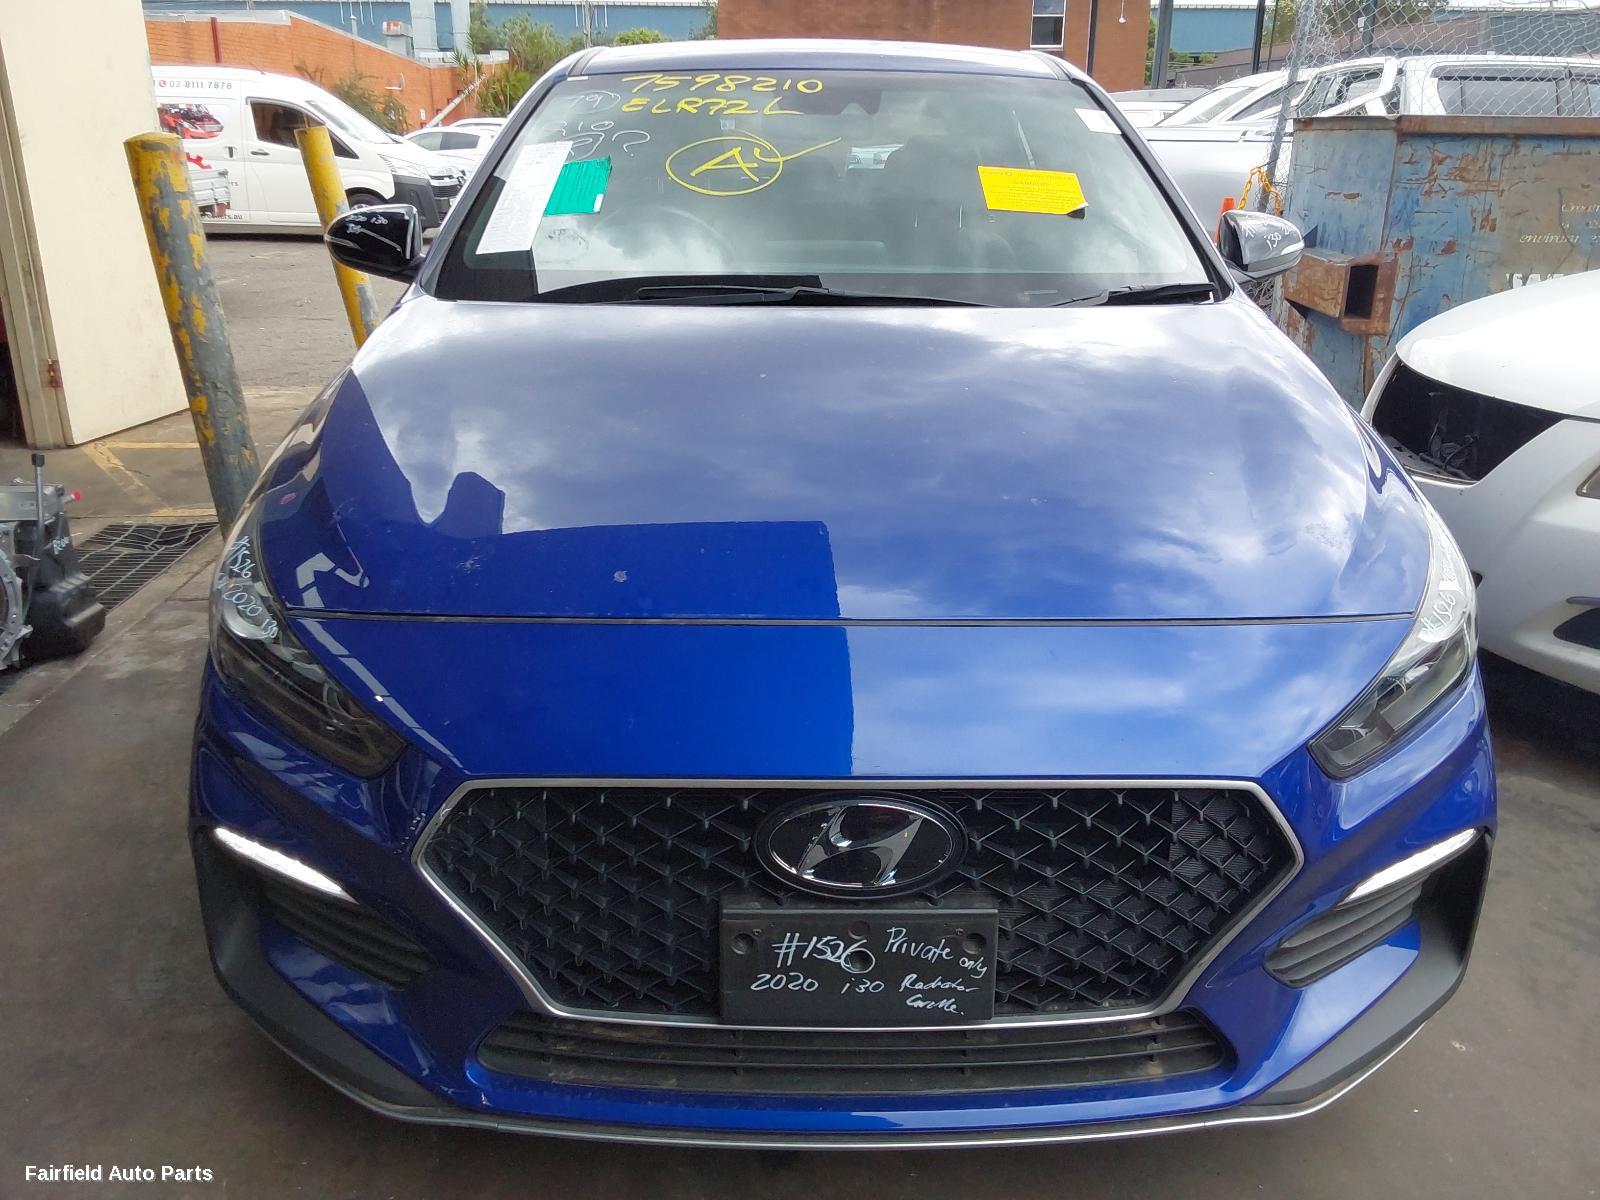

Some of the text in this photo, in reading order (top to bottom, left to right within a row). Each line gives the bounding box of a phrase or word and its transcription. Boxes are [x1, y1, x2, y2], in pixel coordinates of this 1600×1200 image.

[169, 80, 181, 88] 02
[185, 80, 204, 89] 8111
[621, 73, 823, 94] 7598210
[1263, 232, 1282, 251] i30
[223, 584, 263, 617] 2020
[771, 926, 988, 979] #1526 Private only
[750, 972, 819, 992] 2020
[841, 977, 885, 994] i30
